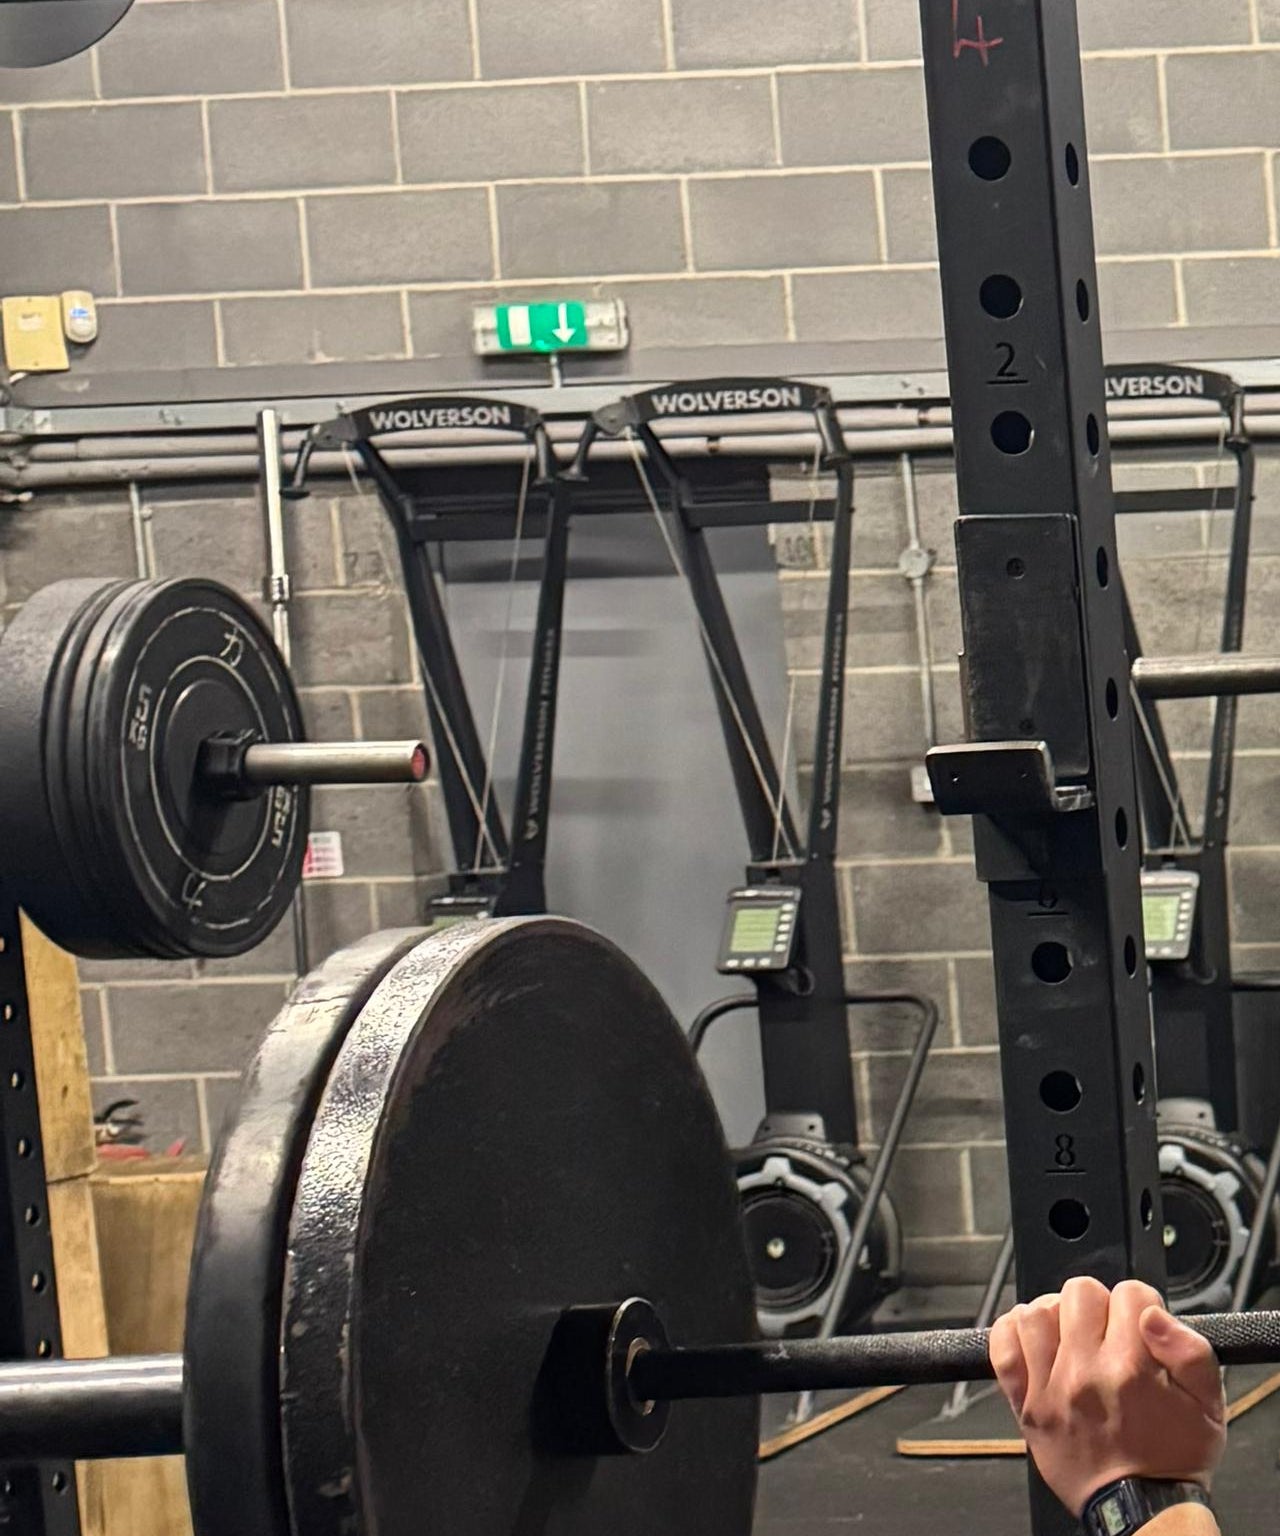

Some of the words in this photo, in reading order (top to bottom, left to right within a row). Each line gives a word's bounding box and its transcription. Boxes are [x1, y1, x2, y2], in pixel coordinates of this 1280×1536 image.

[1104, 374, 1204, 398] LVERSON
[653, 387, 801, 414] WOLVERSON
[368, 406, 511, 431] WOLVERSON
